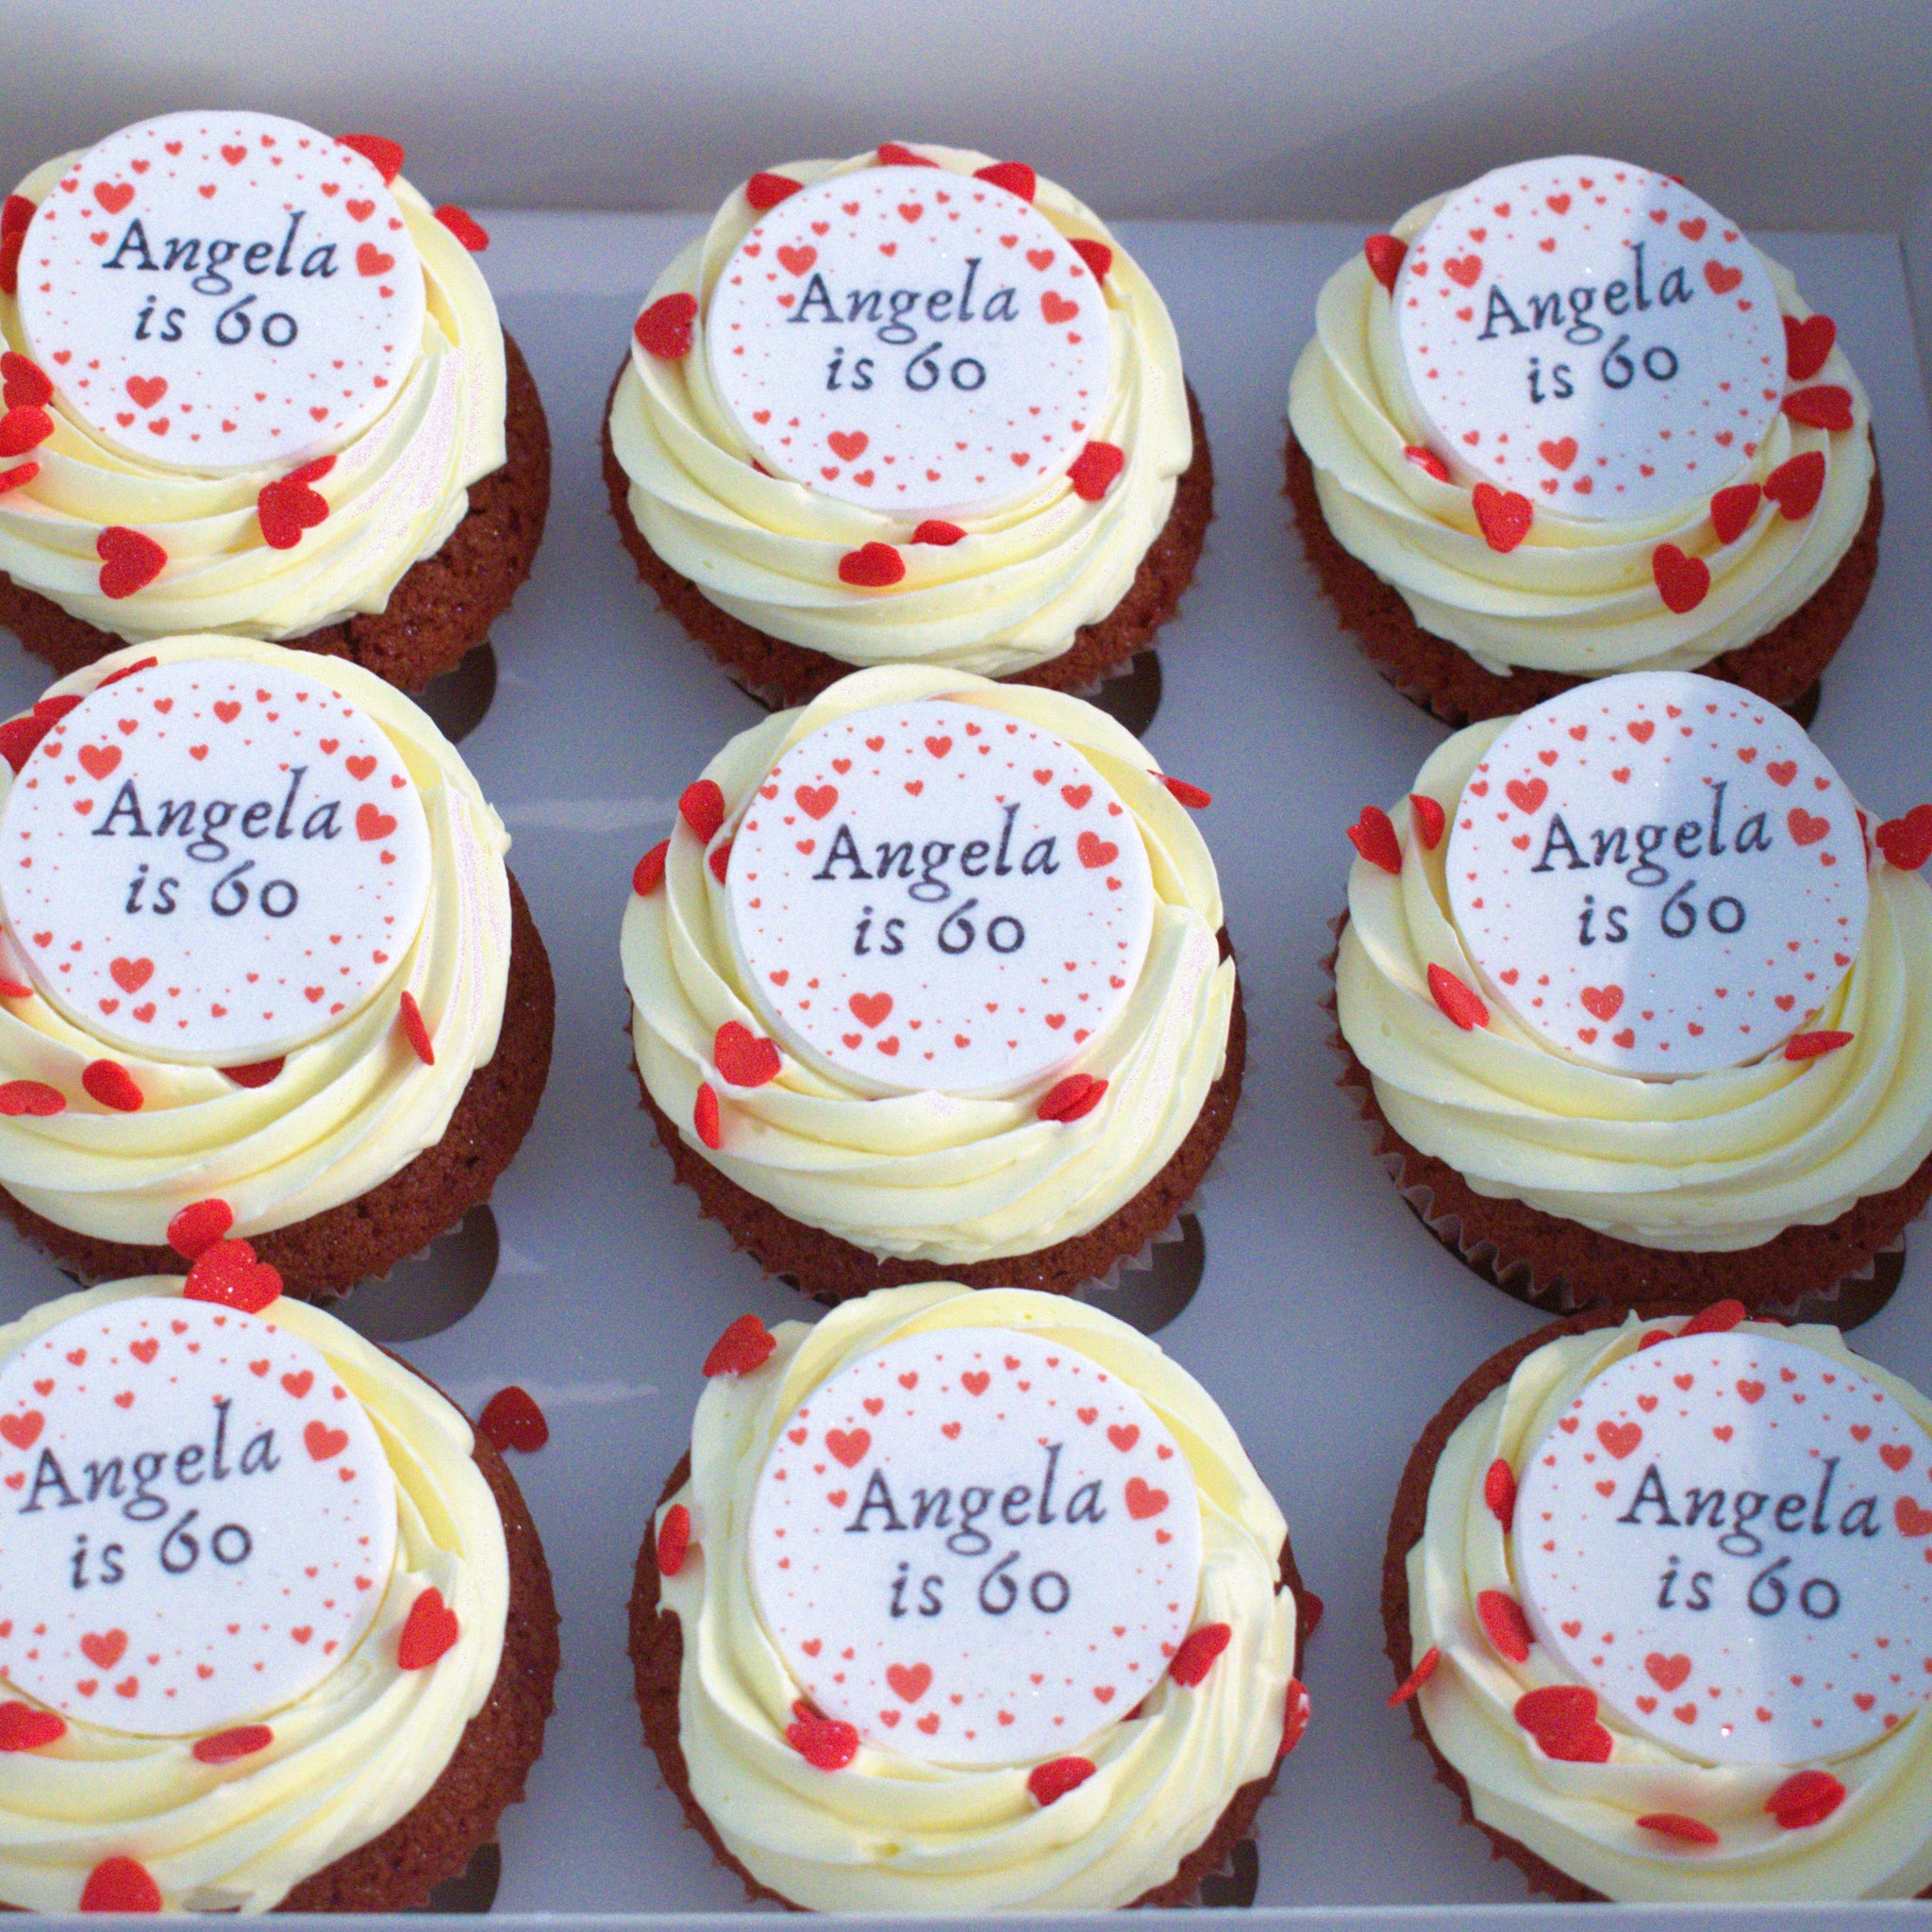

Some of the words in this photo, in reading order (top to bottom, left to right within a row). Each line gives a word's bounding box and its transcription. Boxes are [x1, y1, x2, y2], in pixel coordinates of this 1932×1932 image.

[103, 211, 337, 295] Angela
[136, 295, 185, 342] is
[216, 294, 298, 347] 60
[788, 258, 1017, 344] Angela
[1477, 244, 1693, 345] Angela
[826, 347, 874, 391] is
[905, 341, 986, 391] 60
[1527, 358, 1574, 404] is
[1600, 335, 1678, 390] 60
[92, 766, 341, 862] Angela
[812, 803, 1059, 903] Angela
[1531, 782, 1772, 887] Angela
[126, 864, 179, 915] is
[211, 860, 298, 918] 60
[854, 906, 905, 956] is
[938, 898, 1024, 954] 60
[1578, 894, 1627, 946] is
[1660, 879, 1745, 939] 60
[20, 1398, 280, 1521] Angela
[844, 1443, 1106, 1556] Angela
[72, 1534, 125, 1589] is
[160, 1508, 253, 1574] 60
[1616, 1457, 1880, 1558] Angela
[891, 1561, 943, 1618] is
[979, 1551, 1070, 1616] 60
[1657, 1555, 1712, 1611] is
[1747, 1556, 1840, 1620] 60
